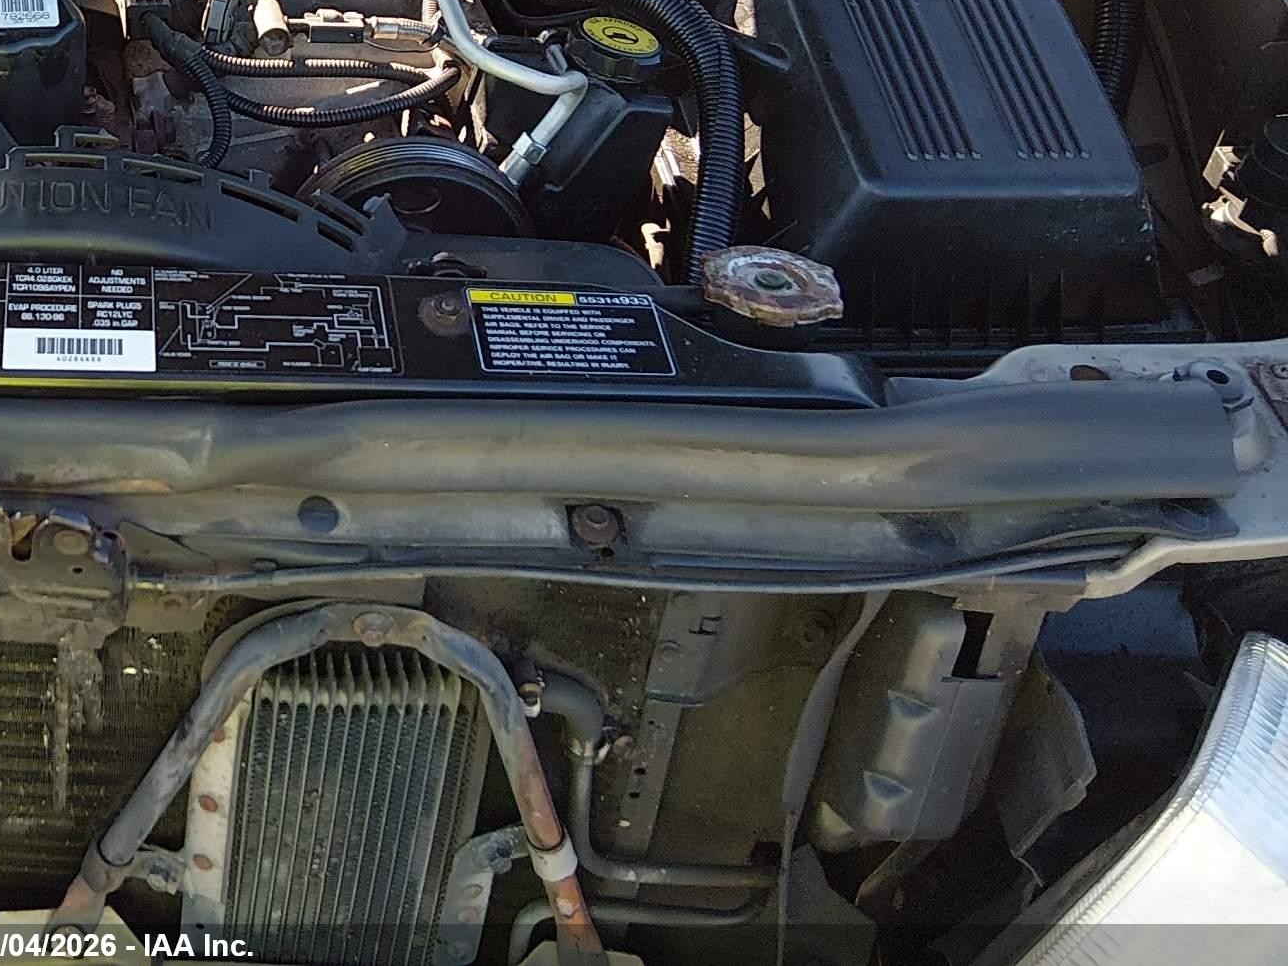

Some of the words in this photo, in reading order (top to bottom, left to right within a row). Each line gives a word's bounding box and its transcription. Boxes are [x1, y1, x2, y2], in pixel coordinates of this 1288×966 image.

[128, 183, 212, 230] FAN
[87, 276, 147, 285] ADJUSTMENTS
[101, 285, 134, 294] NEEDED
[489, 292, 557, 303] CAUTION
[8, 303, 29, 311] EVAP
[30, 303, 78, 313] PROCEDURE
[87, 300, 115, 309] SPARK
[115, 301, 143, 310] PLUGS
[120, 319, 139, 328] GAP
